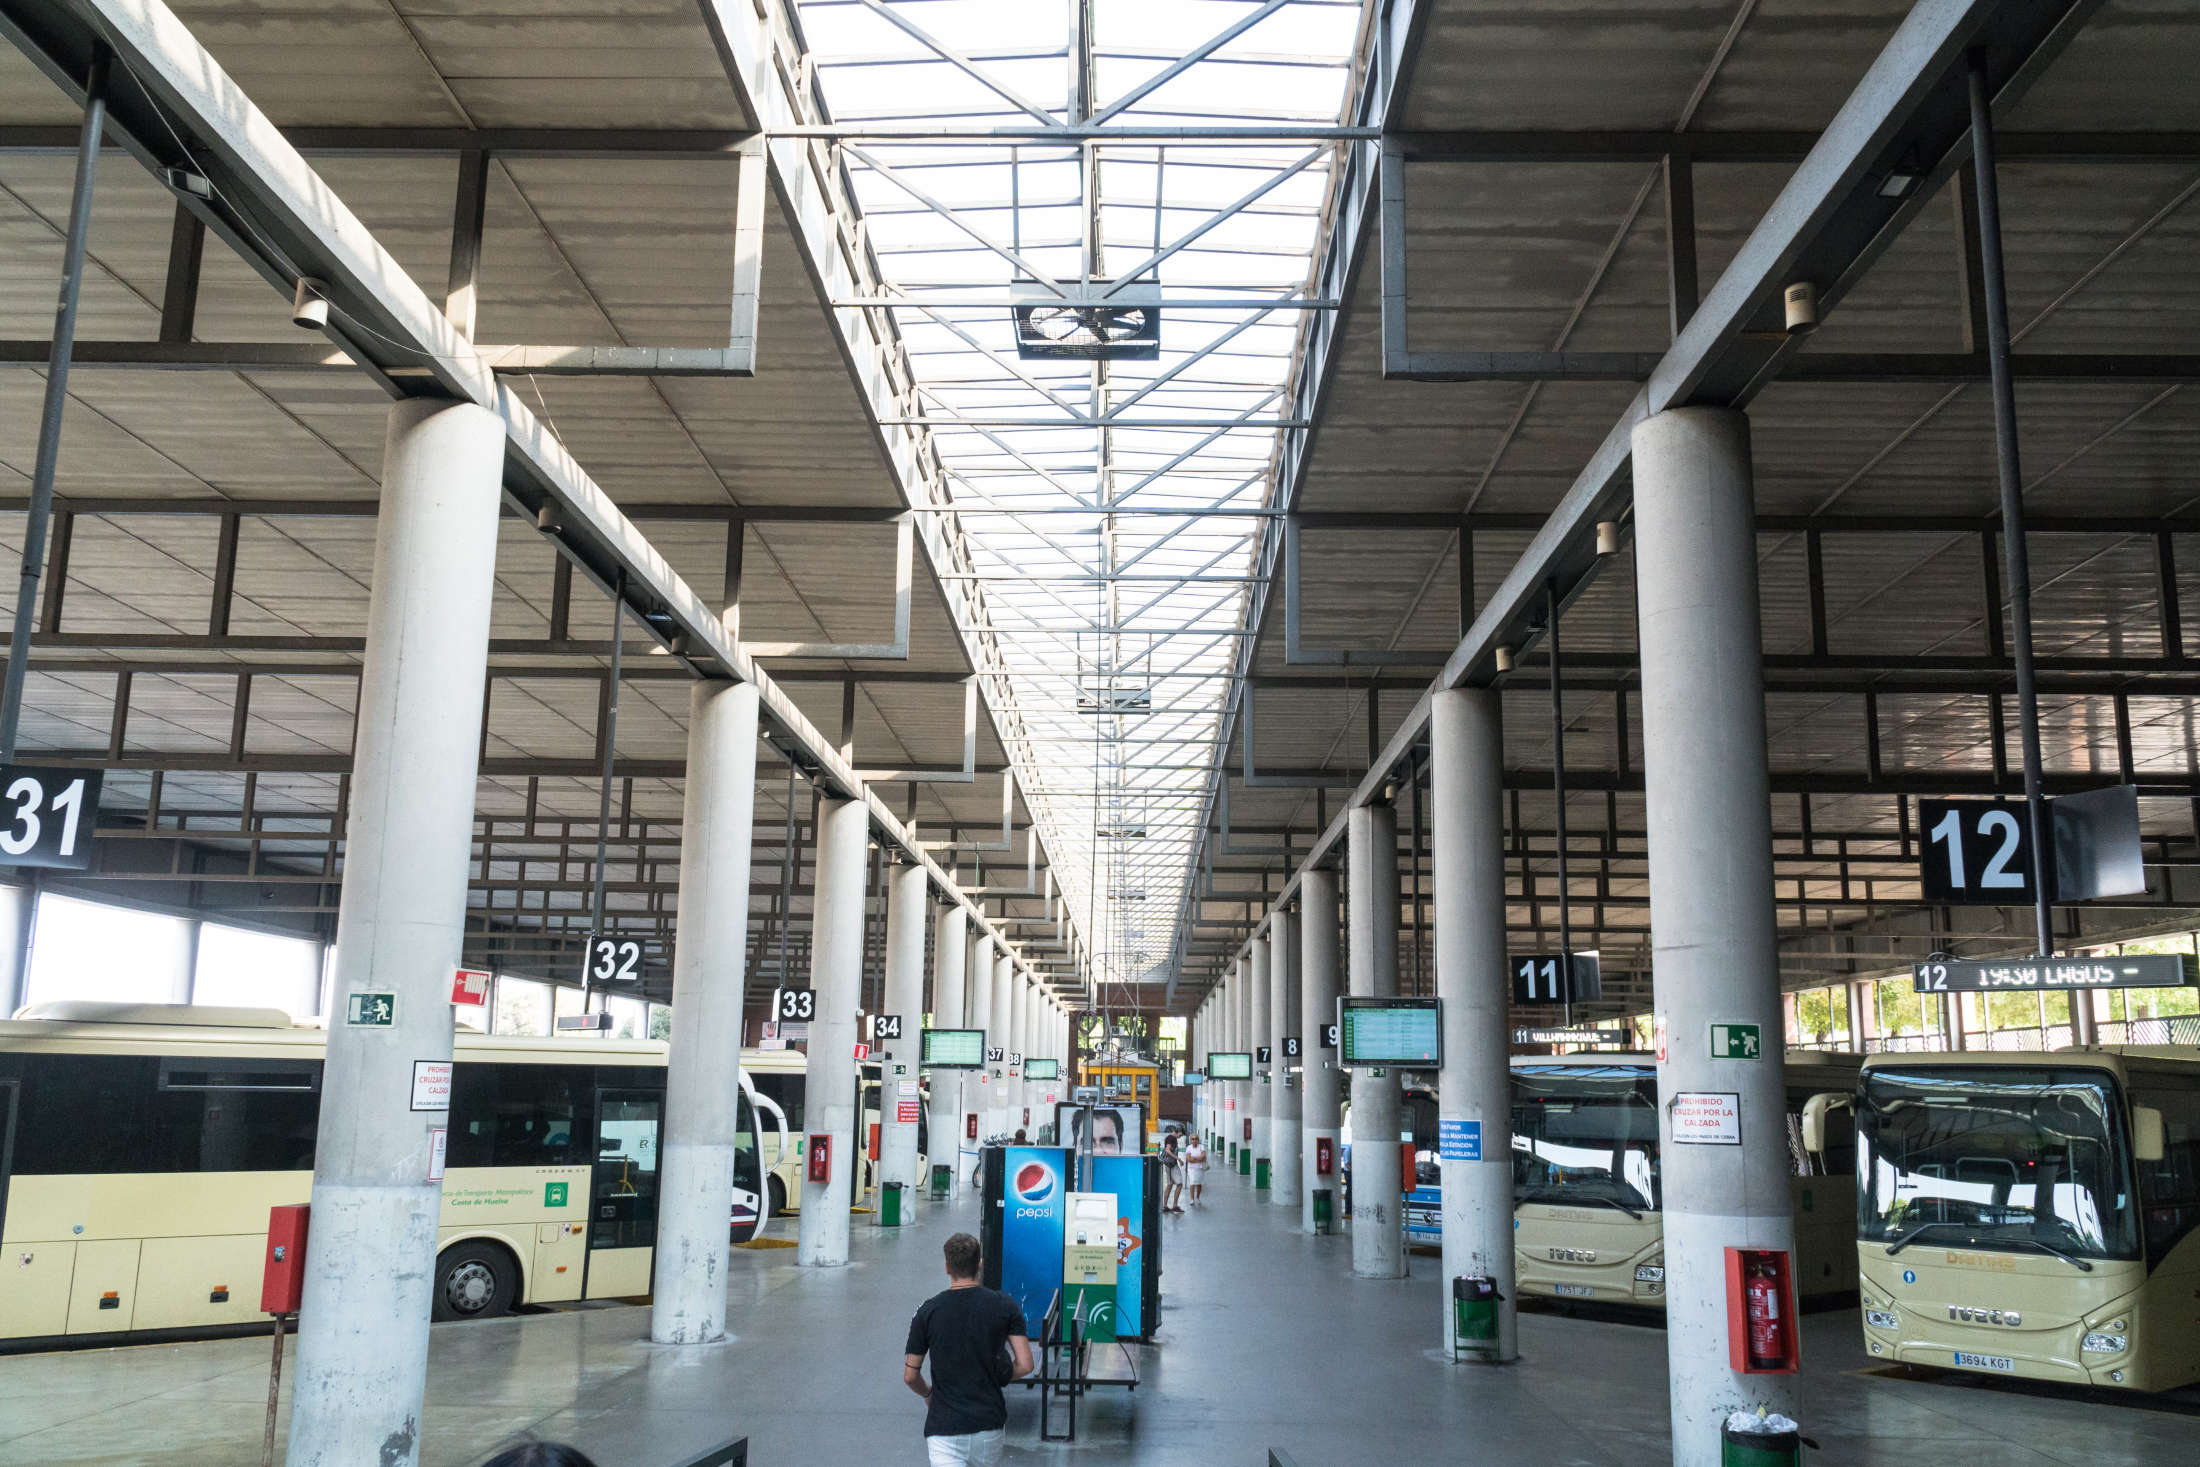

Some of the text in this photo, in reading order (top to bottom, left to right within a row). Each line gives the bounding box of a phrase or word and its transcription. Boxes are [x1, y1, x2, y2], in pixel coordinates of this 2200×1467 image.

[0, 778, 85, 855] 31
[1931, 810, 2024, 888] 12
[594, 941, 639, 980] 32
[1520, 960, 1557, 998] 11
[1919, 965, 1948, 990] 12
[782, 991, 812, 1017] 33
[876, 1017, 899, 1037] 34
[1329, 1025, 1338, 1046] 9
[1516, 1030, 1528, 1043] 11
[989, 1048, 1003, 1060] 37
[1261, 1048, 1270, 1062] 7
[1288, 1038, 1297, 1055] 8
[1009, 1054, 1020, 1065] 38
[1680, 1097, 1723, 1106] PROHIBIDO
[1674, 1108, 1701, 1116] CRUZAR
[1722, 1109, 1733, 1117] LA
[1684, 1119, 1721, 1127] CALZADA
[1016, 1208, 1052, 1220] pepsi
[1550, 1248, 1596, 1262] IVECO
[1947, 1304, 2021, 1326] IVECO
[1960, 1353, 2011, 1370] 3694 KGT
